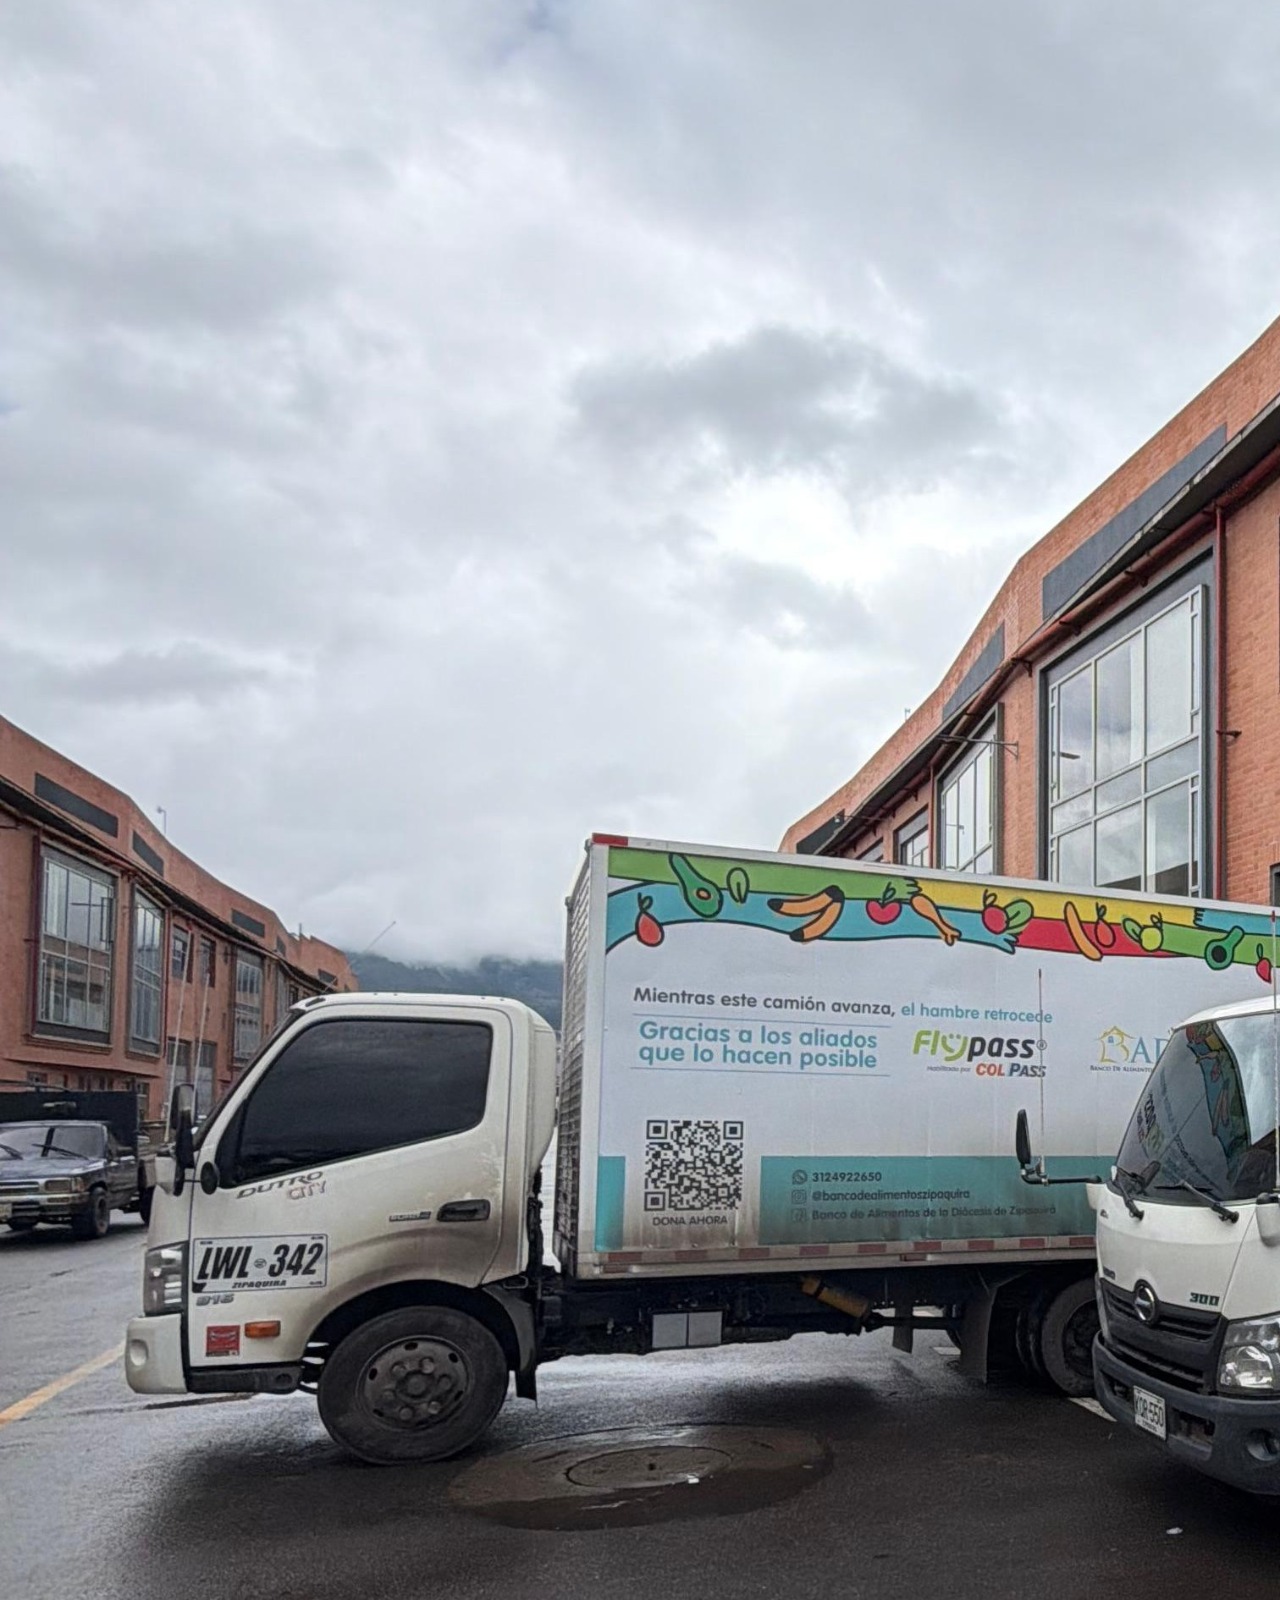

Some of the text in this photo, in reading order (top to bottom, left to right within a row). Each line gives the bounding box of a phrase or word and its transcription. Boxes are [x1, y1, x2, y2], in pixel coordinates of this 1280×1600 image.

[633, 986, 1053, 1024] Mientras este camión avanza, el hambre retrocede
[639, 1020, 878, 1049] Gracias a los aliados
[638, 1043, 878, 1070] que lo hacen posible
[975, 1062, 1005, 1077] COL
[1008, 1062, 1047, 1078] PASS
[237, 1170, 324, 1200] DUTRO
[812, 1171, 882, 1184] 3124922650
[288, 1180, 327, 1200] CITY
[652, 1214, 729, 1227] DONA AHORA
[812, 1207, 848, 1220] Banco
[922, 1206, 937, 1218] de
[196, 1242, 324, 1280] LWL 342
[1190, 1291, 1220, 1307] 300
